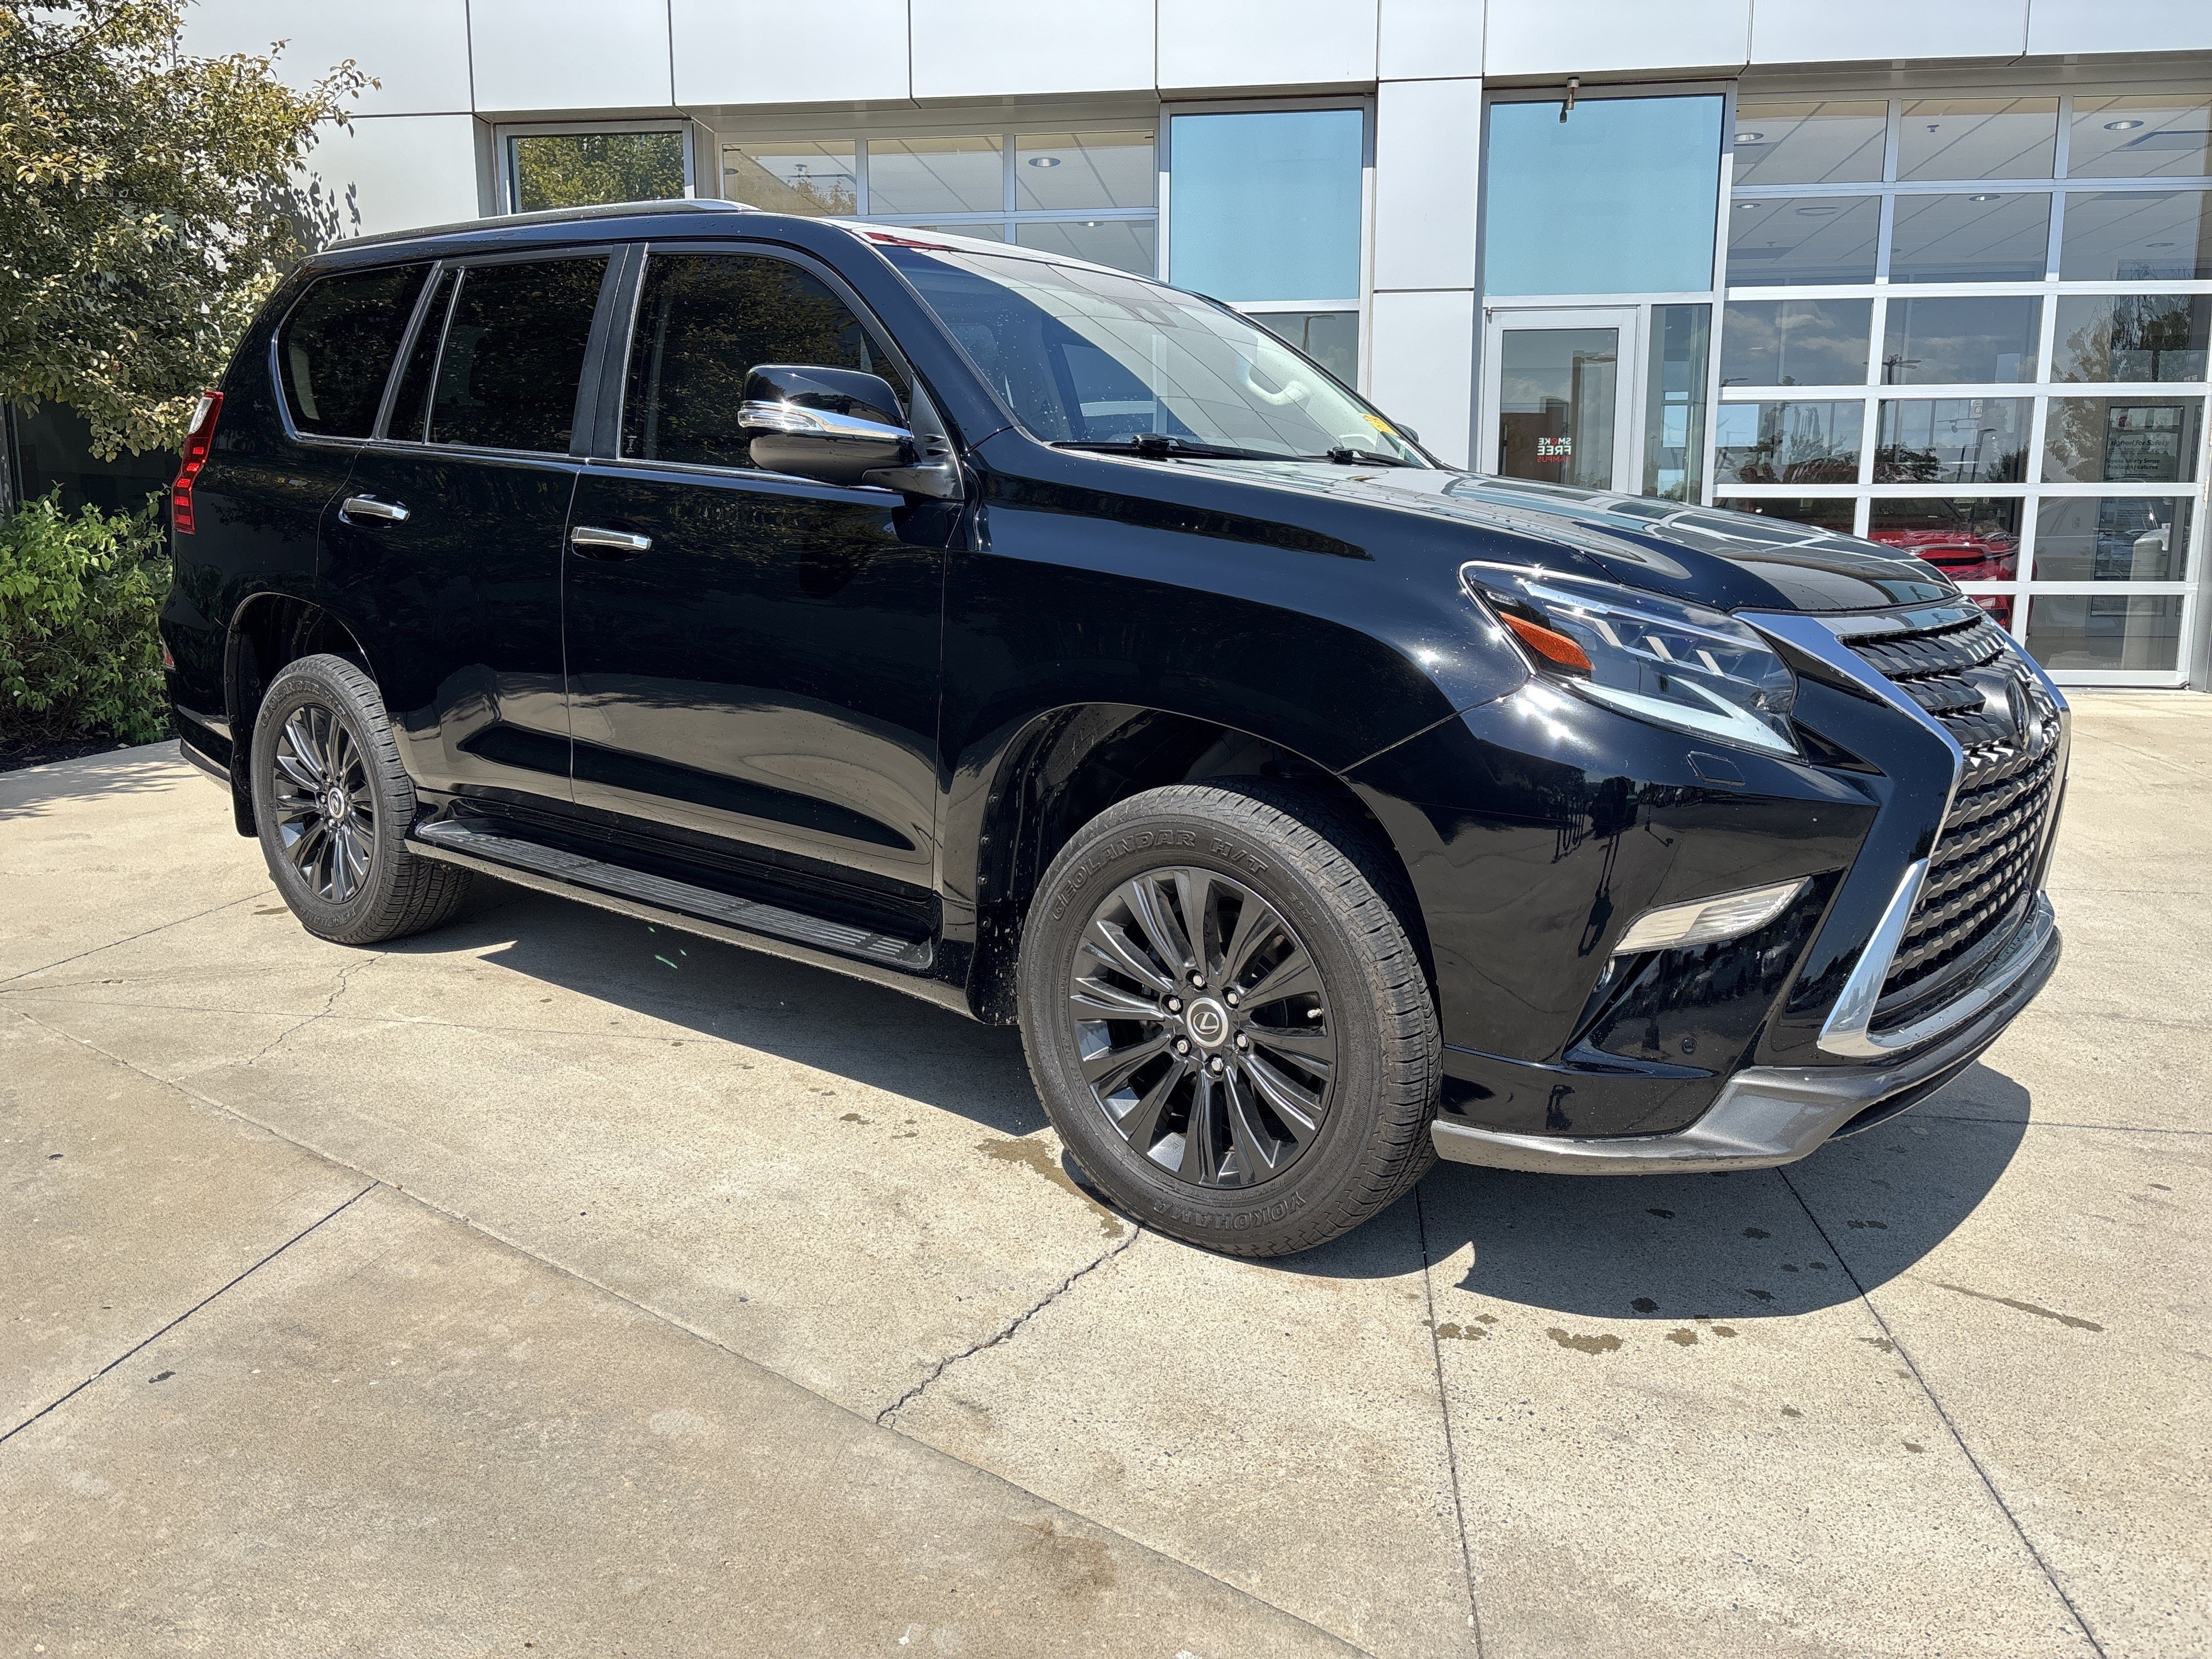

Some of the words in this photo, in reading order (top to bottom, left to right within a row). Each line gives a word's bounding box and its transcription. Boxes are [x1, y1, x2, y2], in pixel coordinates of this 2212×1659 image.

[1052, 829, 1197, 921] GEOLANDAR
[1210, 837, 1269, 874] H/T
[1153, 1190, 1307, 1231] YOKOHAMA
